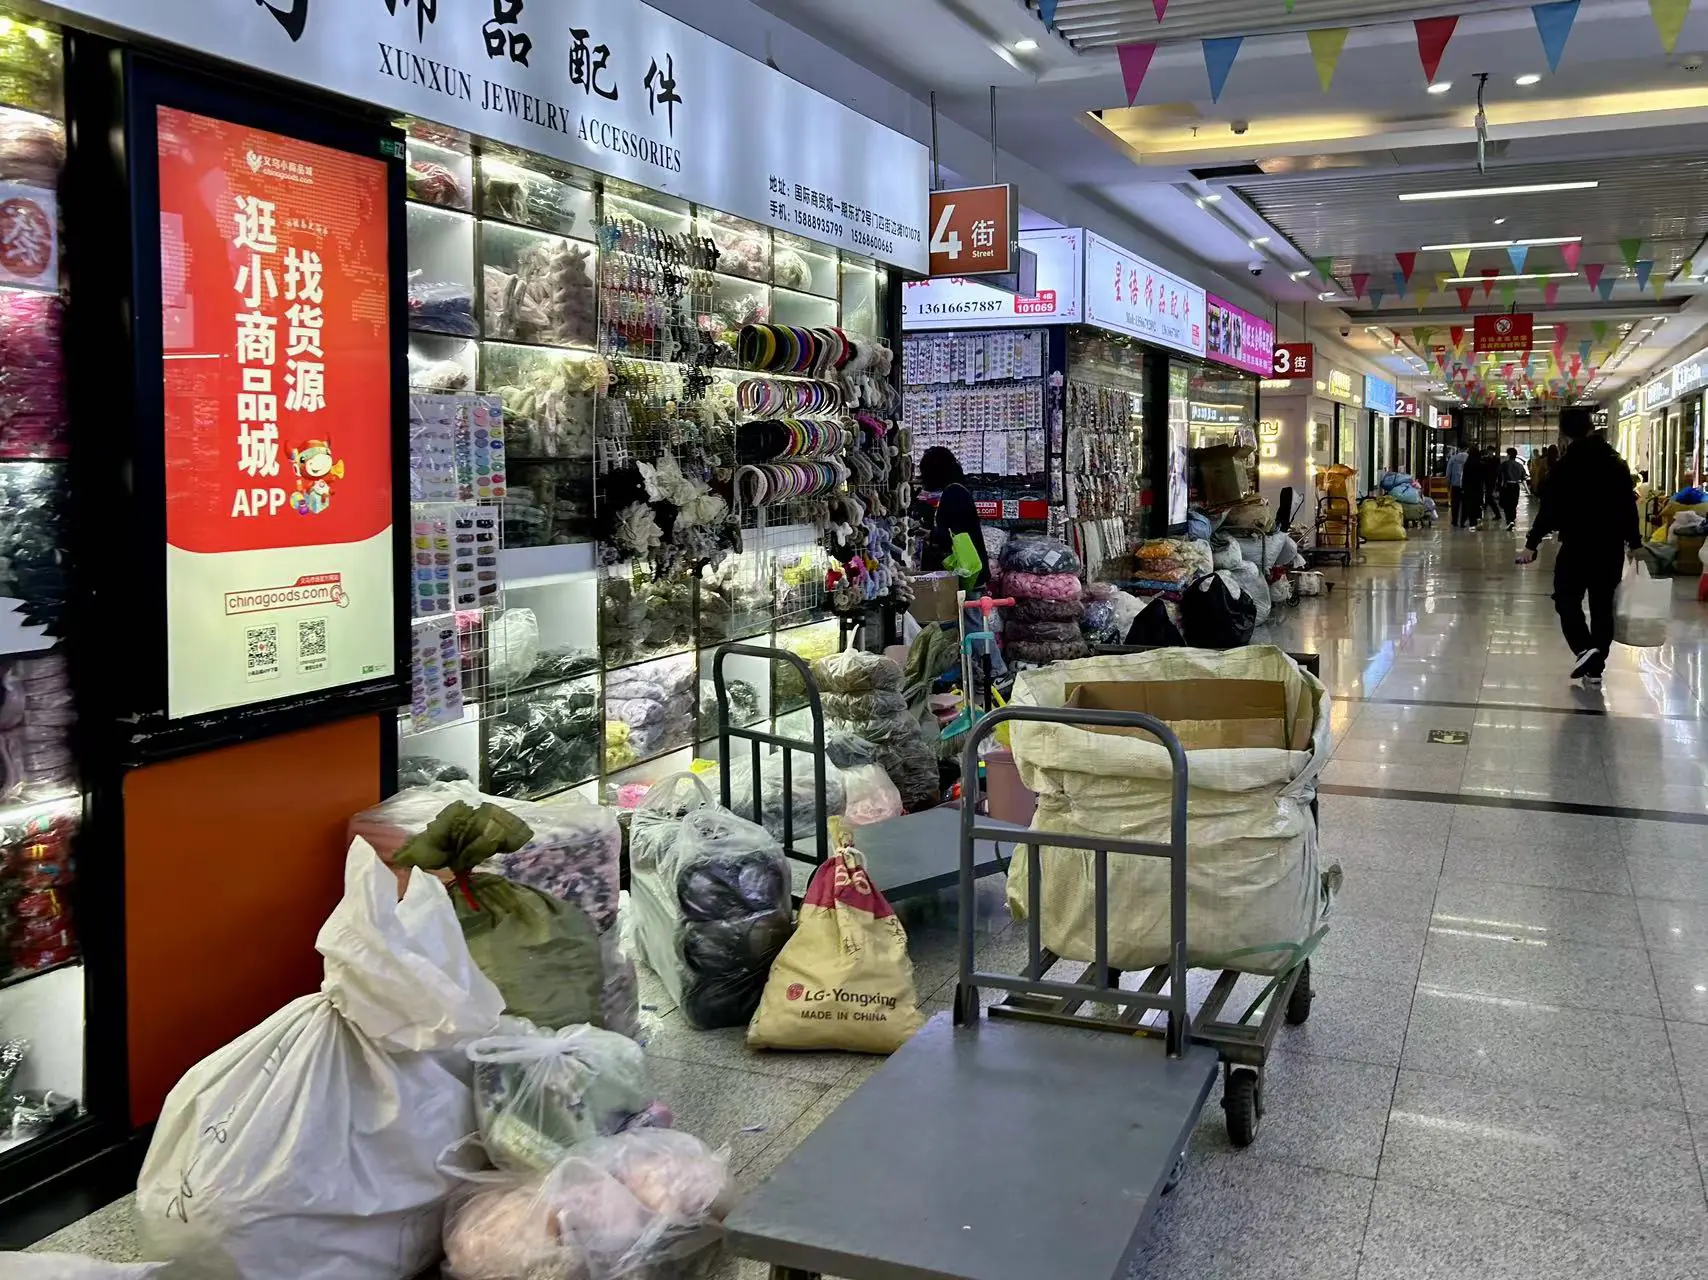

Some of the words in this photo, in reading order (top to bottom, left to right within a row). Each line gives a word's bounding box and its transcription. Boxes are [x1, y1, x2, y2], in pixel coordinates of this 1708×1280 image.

[378, 42, 472, 102] XUNXUN
[481, 80, 570, 135] JEWELRY
[578, 117, 682, 173] ACCESSORIES
[851, 229, 894, 254] 15268600665
[930, 204, 962, 260] 4
[971, 219, 995, 248] 街
[972, 250, 994, 258] Street
[918, 301, 1003, 315] 13616657887
[1016, 303, 1054, 314] 101069
[234, 195, 280, 477] 逛小商品城
[284, 247, 326, 412] 找货源
[1273, 349, 1290, 373] 3
[1294, 356, 1307, 368] 街
[1395, 400, 1405, 413] 2
[231, 488, 286, 517] APP
[229, 586, 329, 608] chinagoods.com
[801, 1010, 833, 1020] MADE
[837, 1011, 848, 1020] IN
[853, 1012, 887, 1022] CHINA
